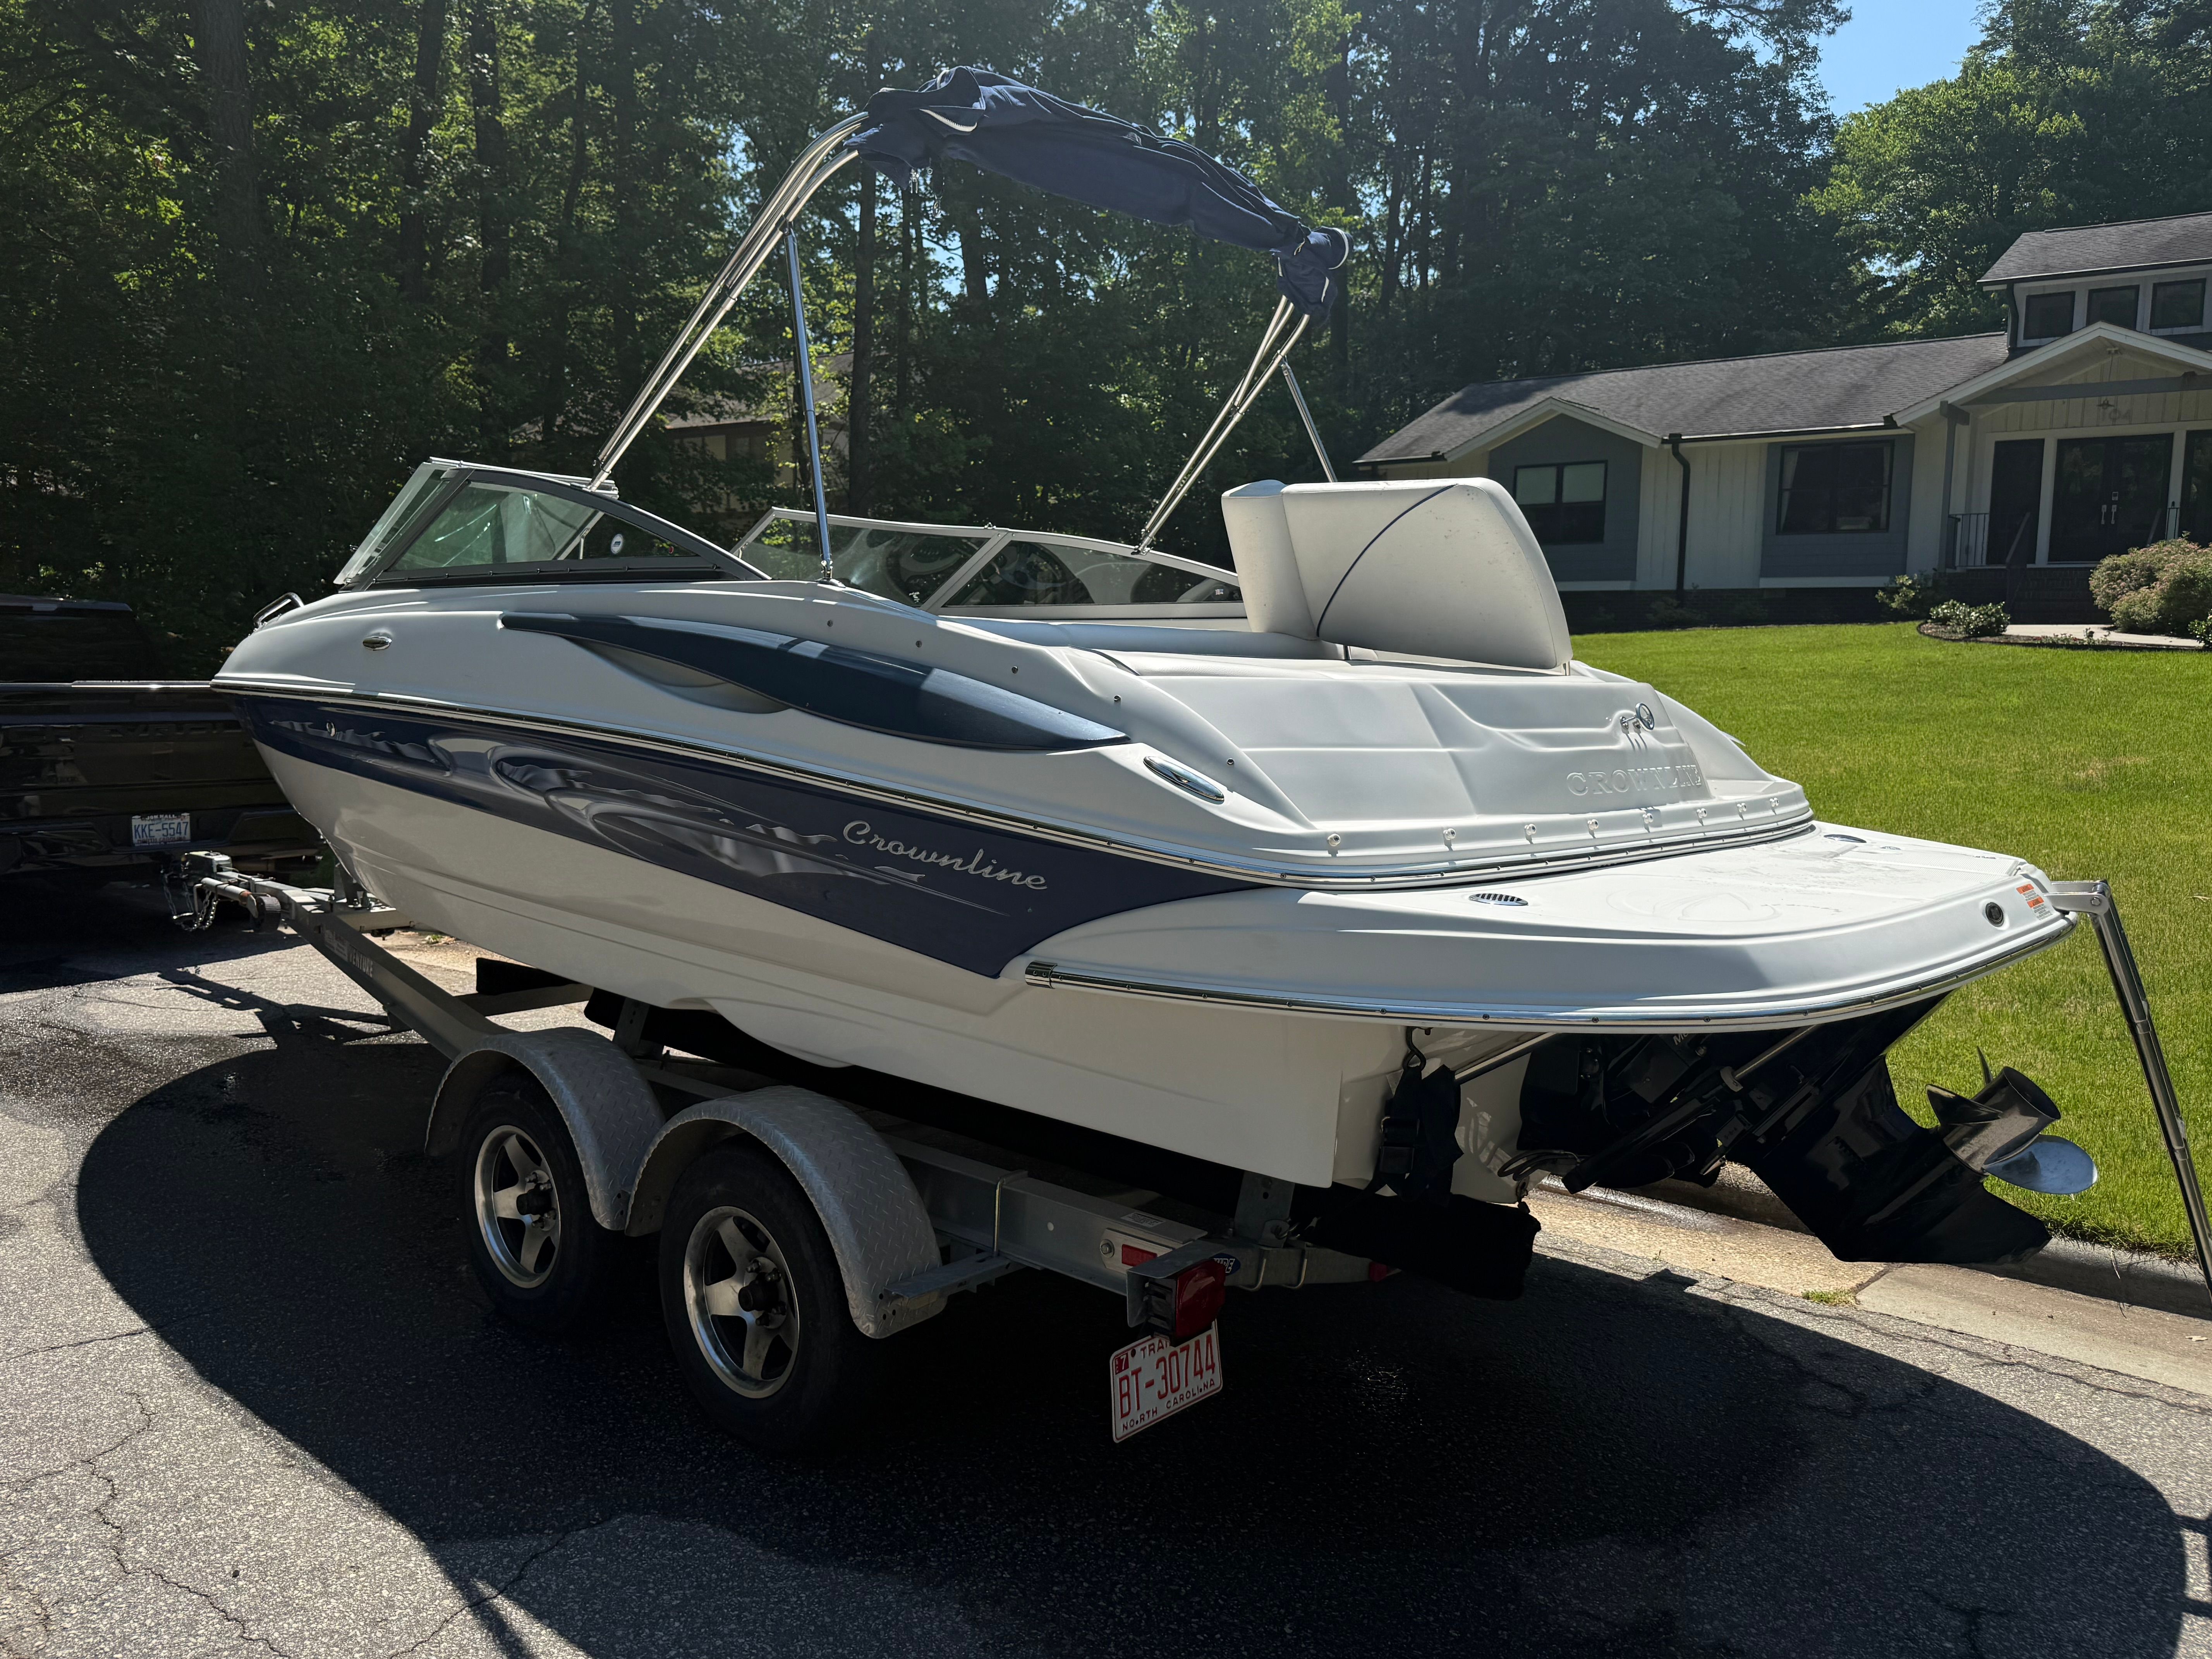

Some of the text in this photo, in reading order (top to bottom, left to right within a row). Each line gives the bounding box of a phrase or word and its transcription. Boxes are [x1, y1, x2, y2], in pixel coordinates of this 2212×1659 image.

[1566, 764, 1703, 796] CROWNLINE
[134, 821, 189, 839] KKE-5547
[843, 820, 1048, 890] Crownline
[1120, 1354, 1127, 1370] 7
[1140, 1338, 1168, 1358] TRAI
[1118, 1334, 1215, 1419] BT-30744
[1123, 1378, 1215, 1432] NORTH CAROLINA
